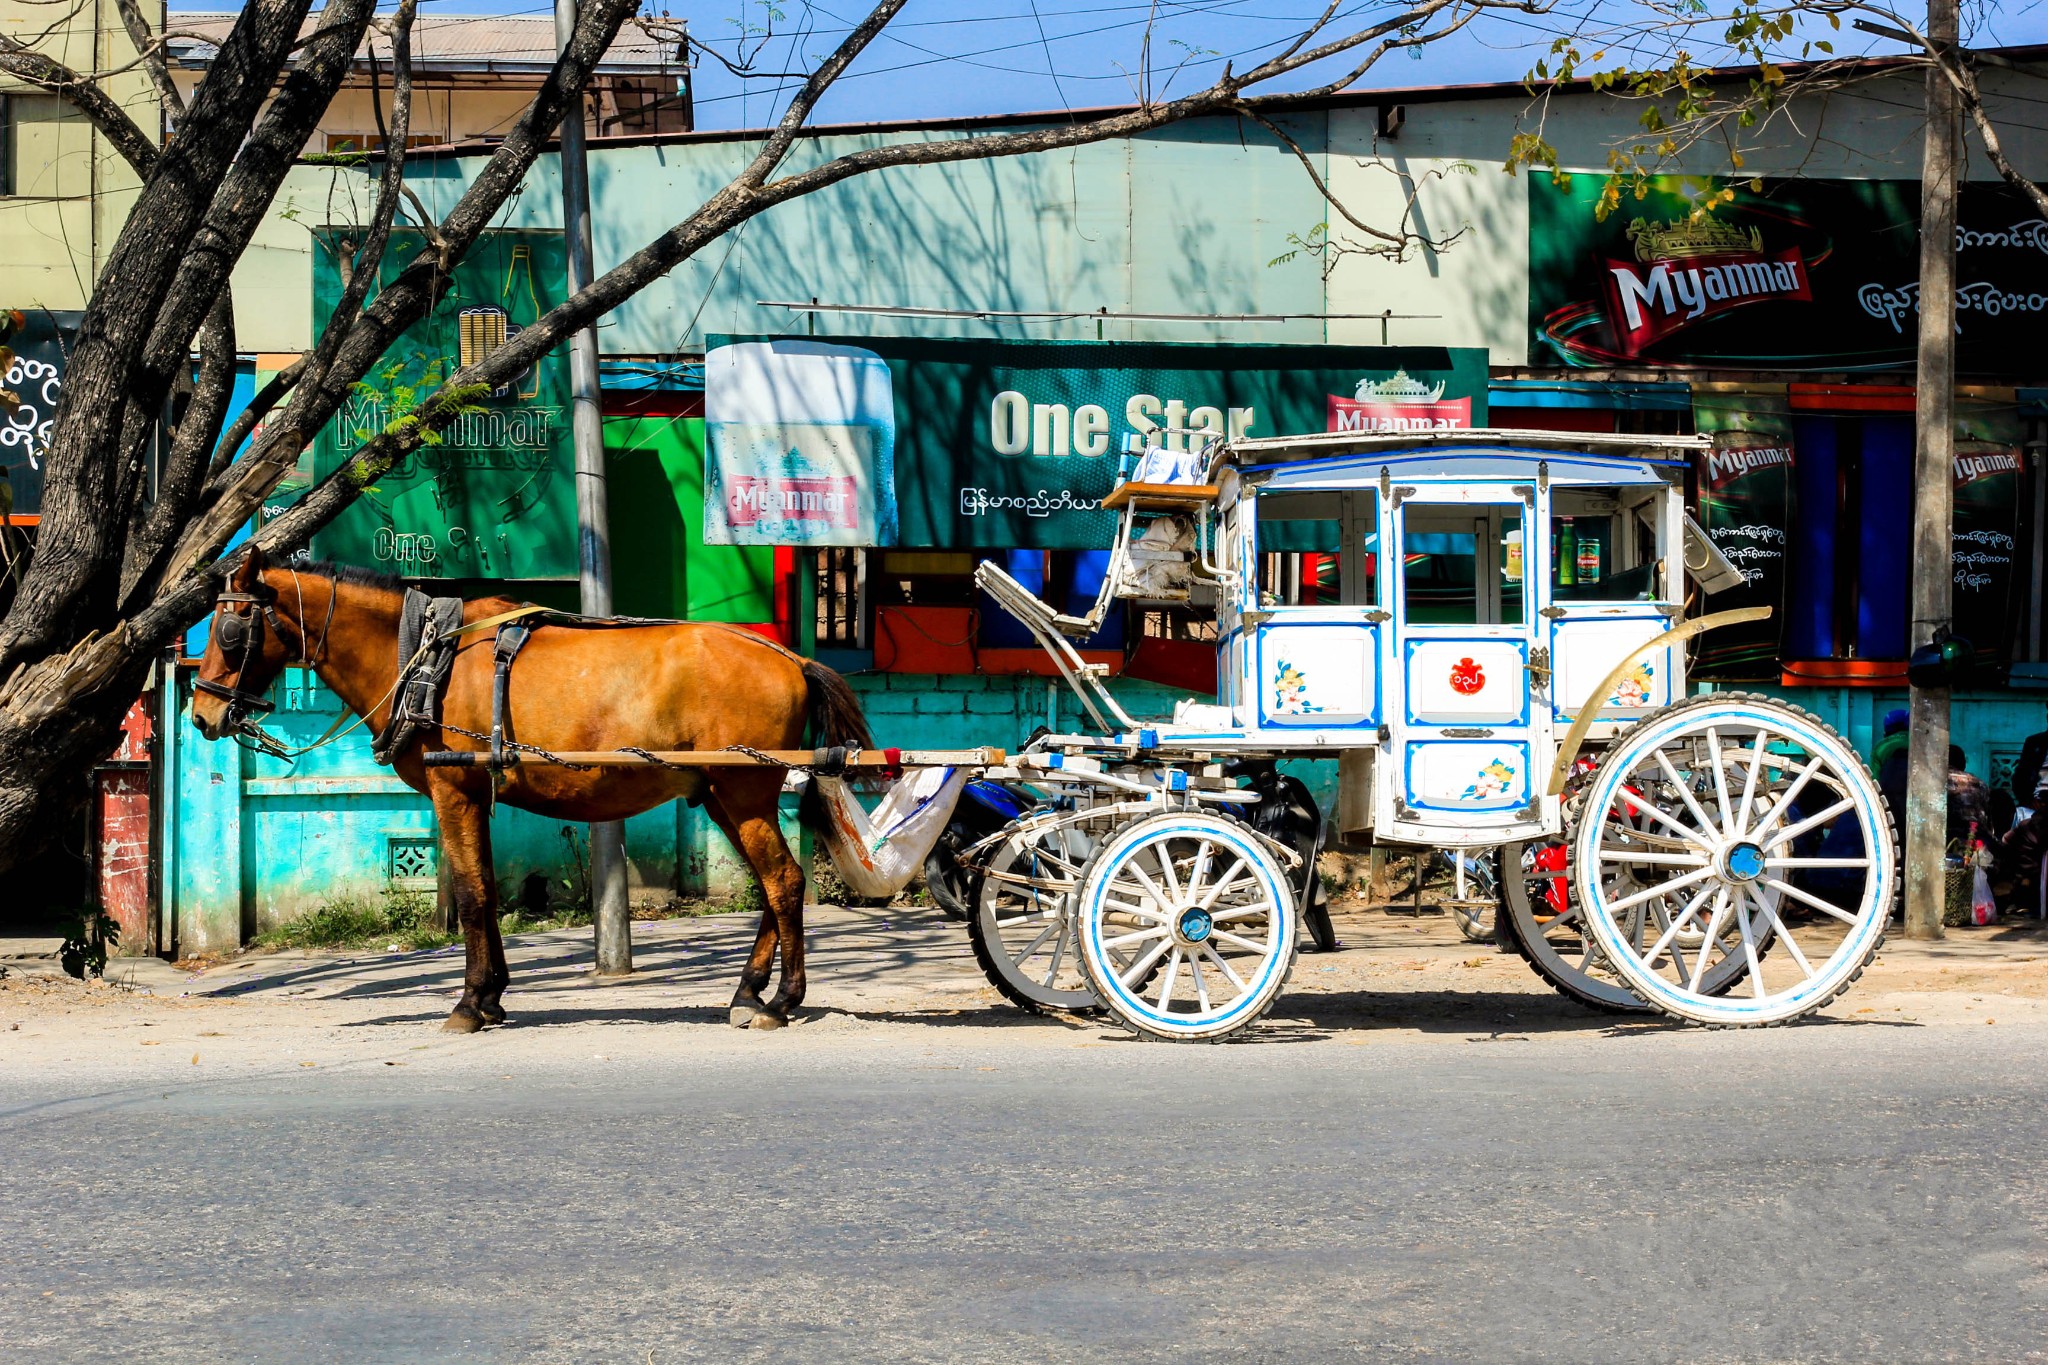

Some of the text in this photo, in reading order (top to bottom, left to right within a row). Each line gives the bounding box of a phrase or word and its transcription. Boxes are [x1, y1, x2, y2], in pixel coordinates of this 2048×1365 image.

[1610, 261, 1800, 331] Myanmar
[991, 390, 1254, 457] One Star
[735, 485, 849, 515] Myanmar
[373, 526, 436, 562] One
